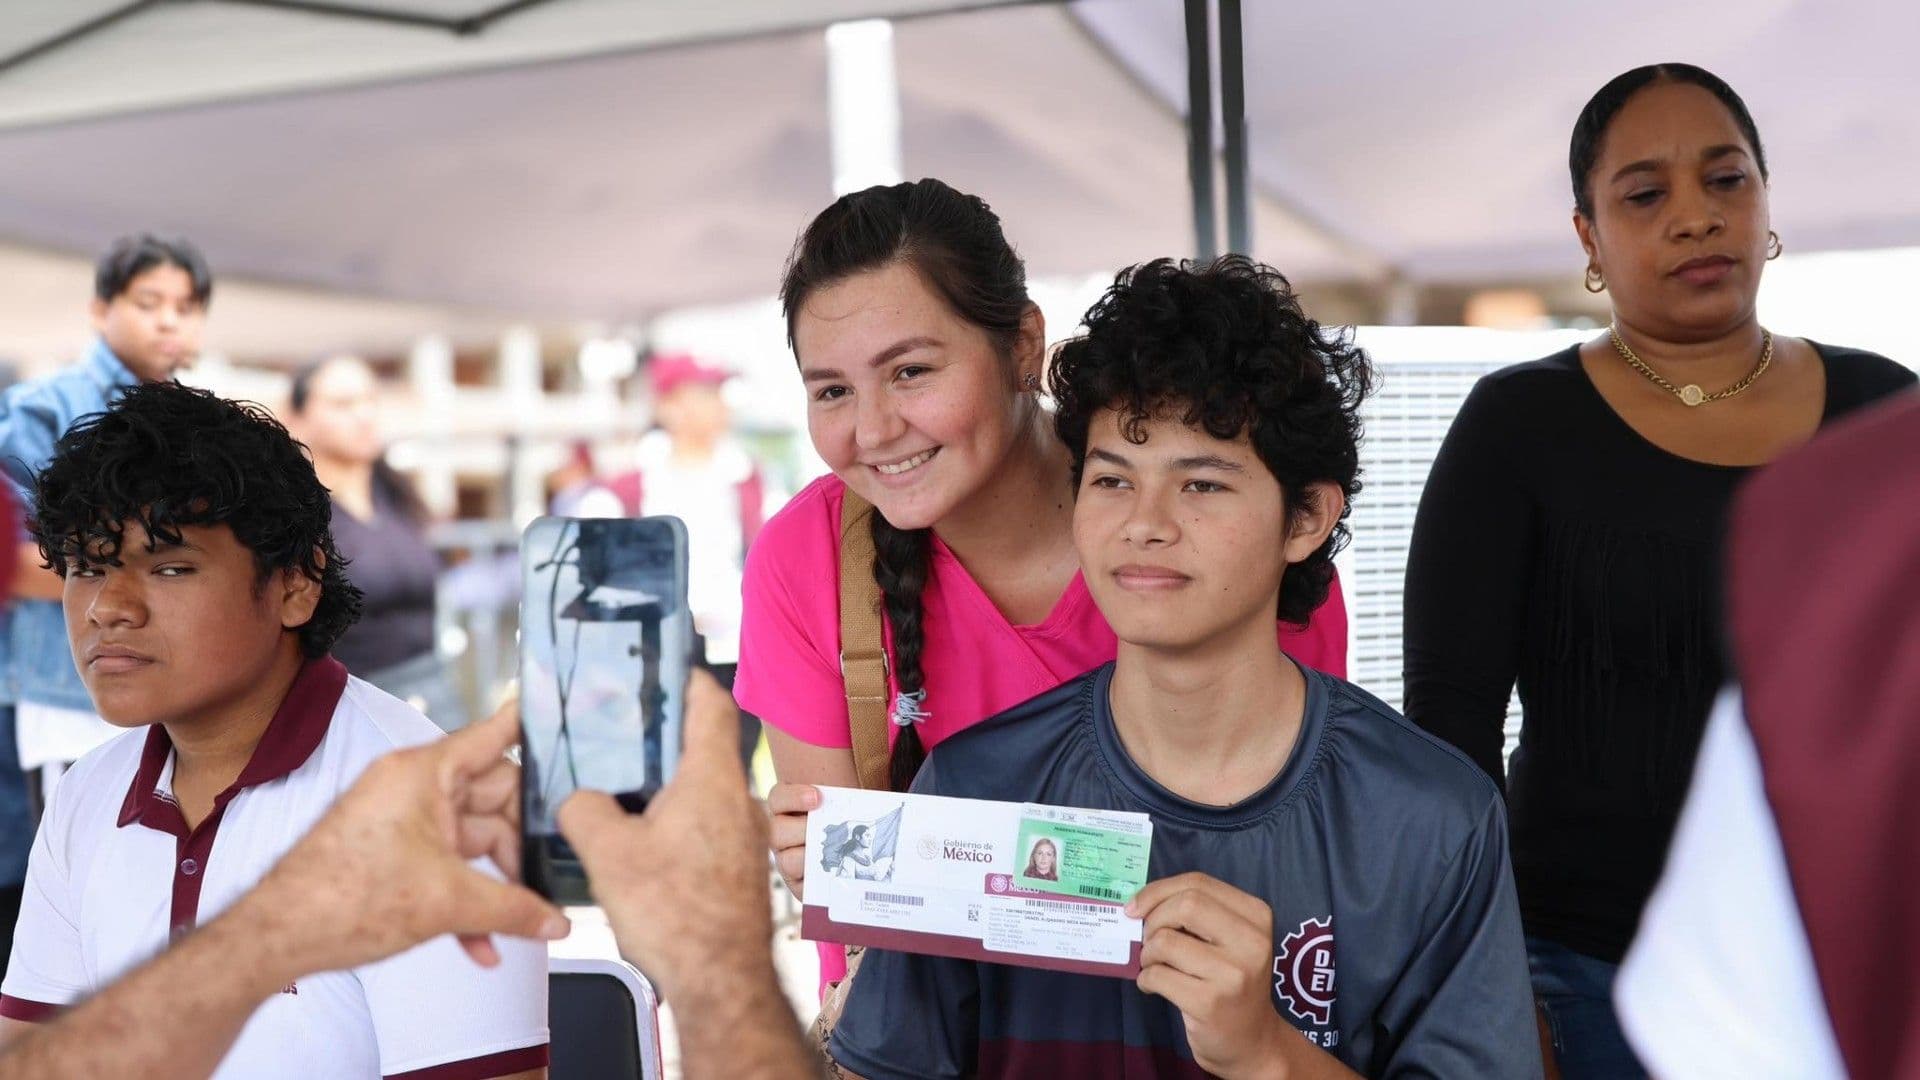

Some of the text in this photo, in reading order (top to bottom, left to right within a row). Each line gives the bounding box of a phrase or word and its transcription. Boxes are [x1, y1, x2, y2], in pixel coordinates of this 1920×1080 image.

[944, 839, 993, 850] Gobierno de
[943, 846, 993, 863] México
